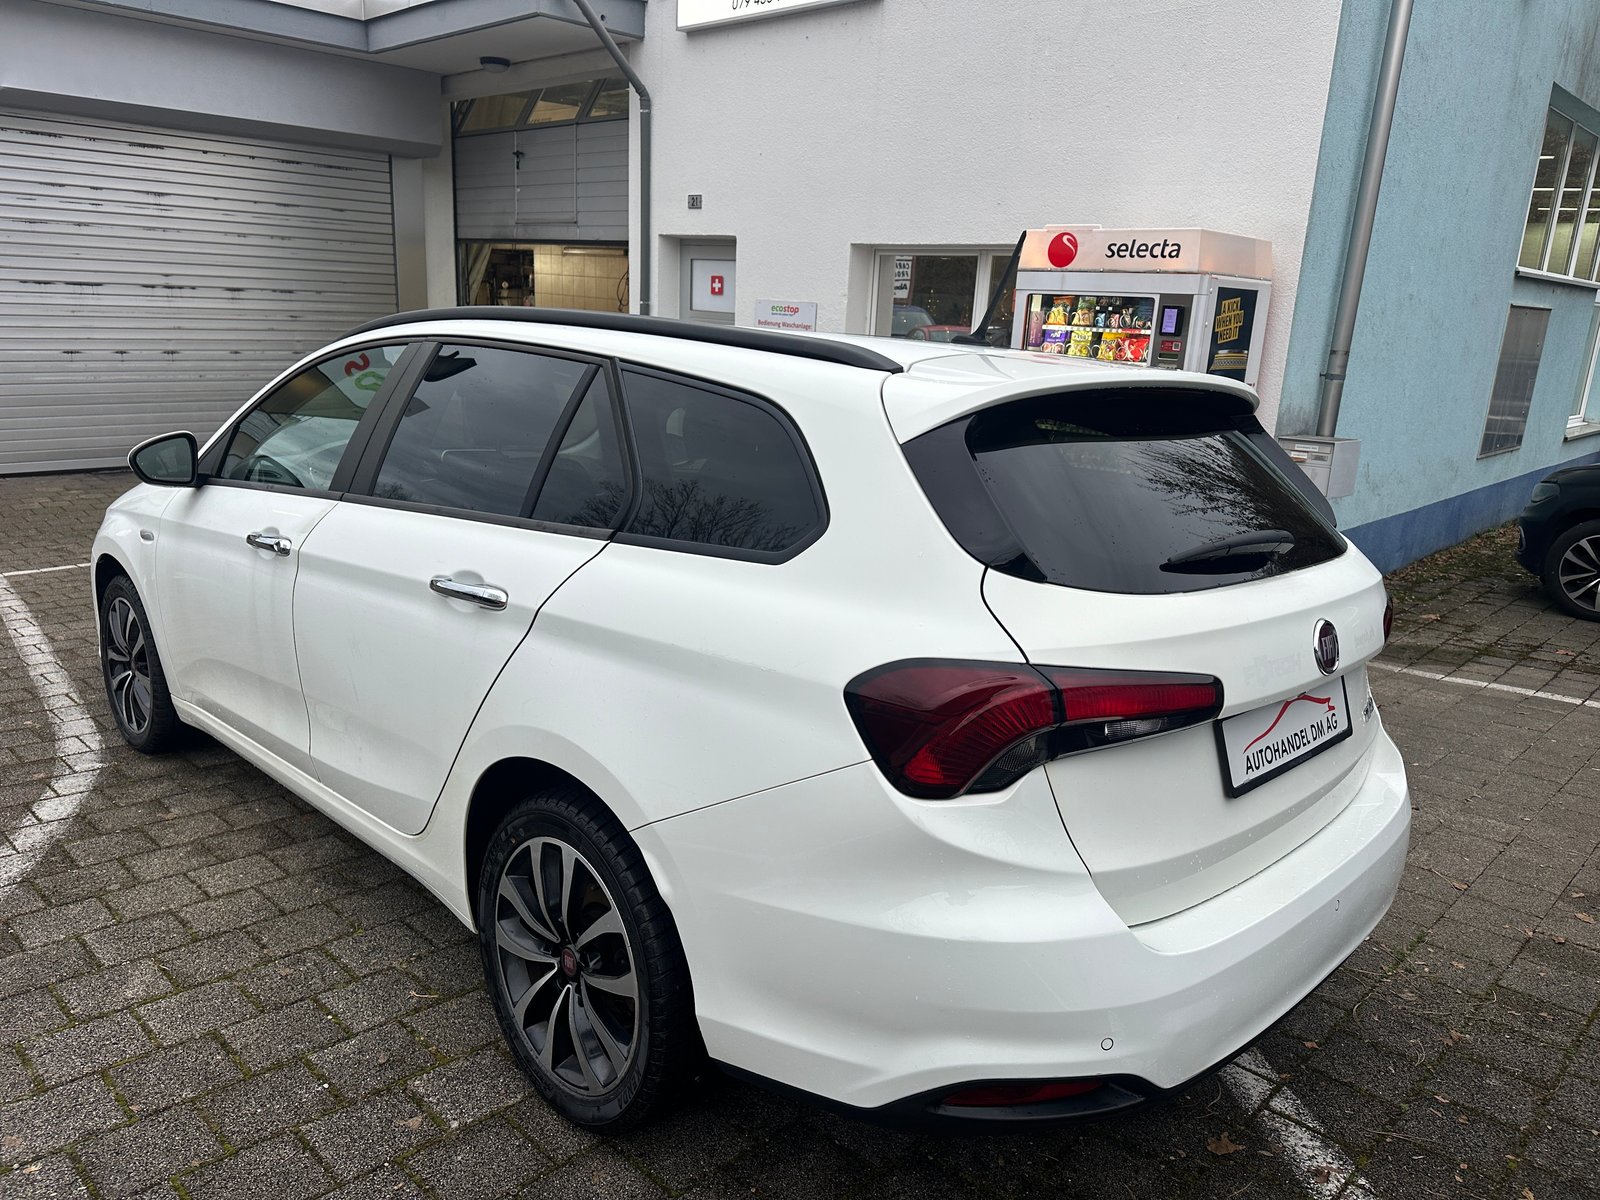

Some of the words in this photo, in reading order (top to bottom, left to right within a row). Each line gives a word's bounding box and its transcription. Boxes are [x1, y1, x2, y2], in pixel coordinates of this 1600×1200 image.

[690, 197, 698, 207] 21
[1105, 239, 1182, 259] selecta
[771, 305, 799, 315] ecostop
[1227, 299, 1240, 313] KICK
[758, 319, 781, 328] Bedienung
[1217, 315, 1232, 328] WHEN
[1232, 312, 1243, 326] YOU
[1219, 328, 1232, 341] NEED
[1246, 727, 1311, 775] AUTOHANDEL
[1310, 719, 1326, 742] DM
[1326, 712, 1338, 733] AG
